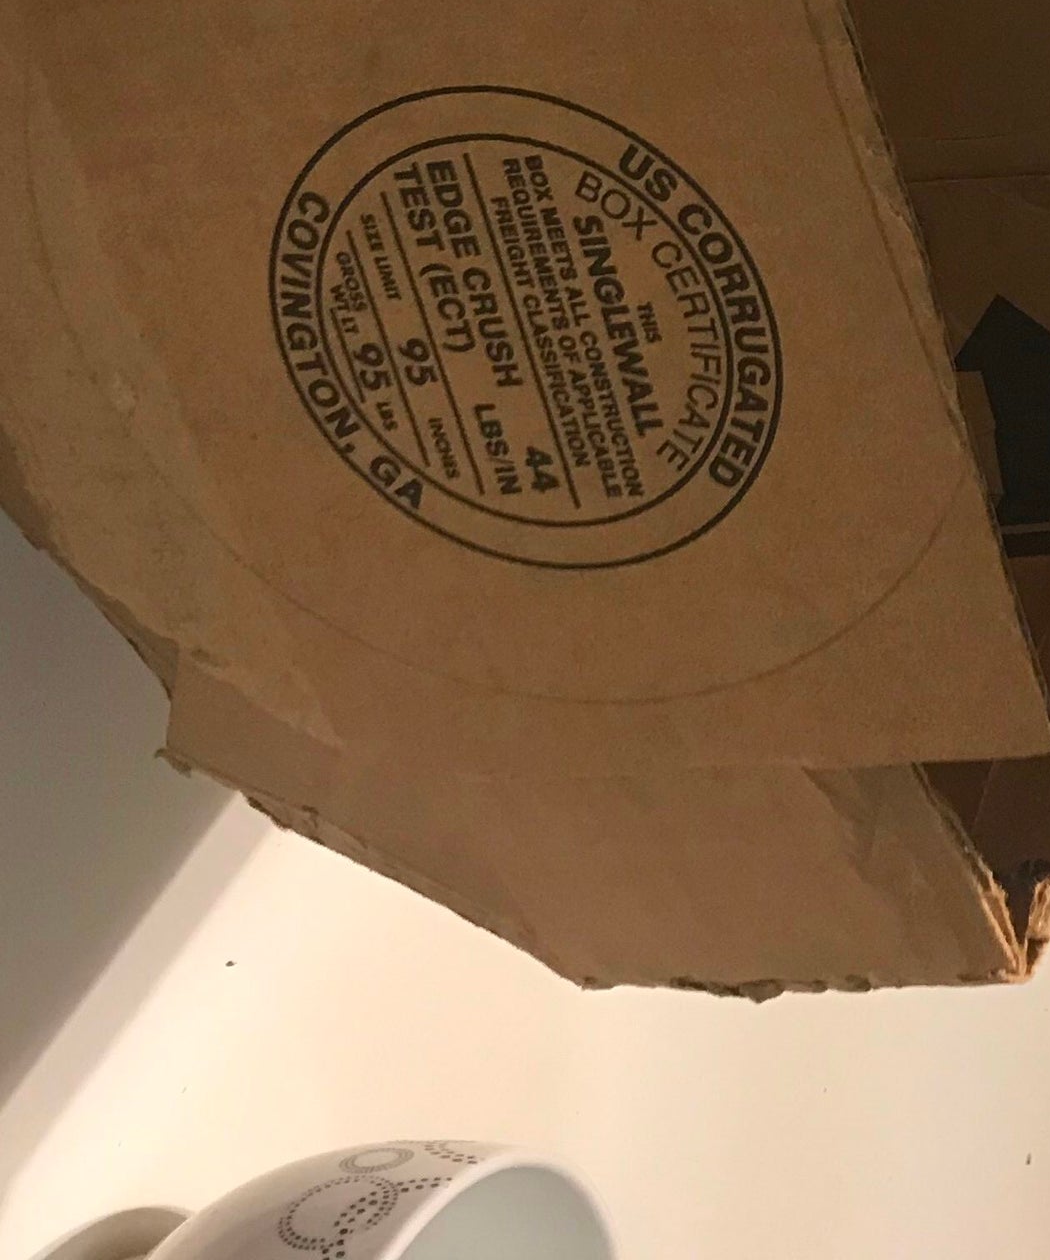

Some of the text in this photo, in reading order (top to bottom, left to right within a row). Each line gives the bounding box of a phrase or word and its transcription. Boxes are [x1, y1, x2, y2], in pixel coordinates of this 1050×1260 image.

[281, 191, 425, 510] COVINGTON, GA
[330, 284, 351, 311] WT
[336, 251, 399, 432] GROSS 95 LBS
[360, 213, 461, 479] SIZE LIMIT 95 INCHES
[393, 161, 524, 495] TEST (ECT) LBS/IN
[426, 160, 560, 493] EDGE CRUSH 44
[490, 196, 591, 468] FREIGHT CLASSIFICATION
[502, 157, 623, 499] REQUIREMENTS OF APPLICABLE
[525, 155, 645, 498] BOX MEETS ALL CONSTRUCTION
[572, 215, 664, 438] SINGLEWALL
[574, 170, 721, 472] BOX CERTIFICATE
[618, 143, 772, 488] US CORRUGATED
[637, 301, 663, 343] THIS
